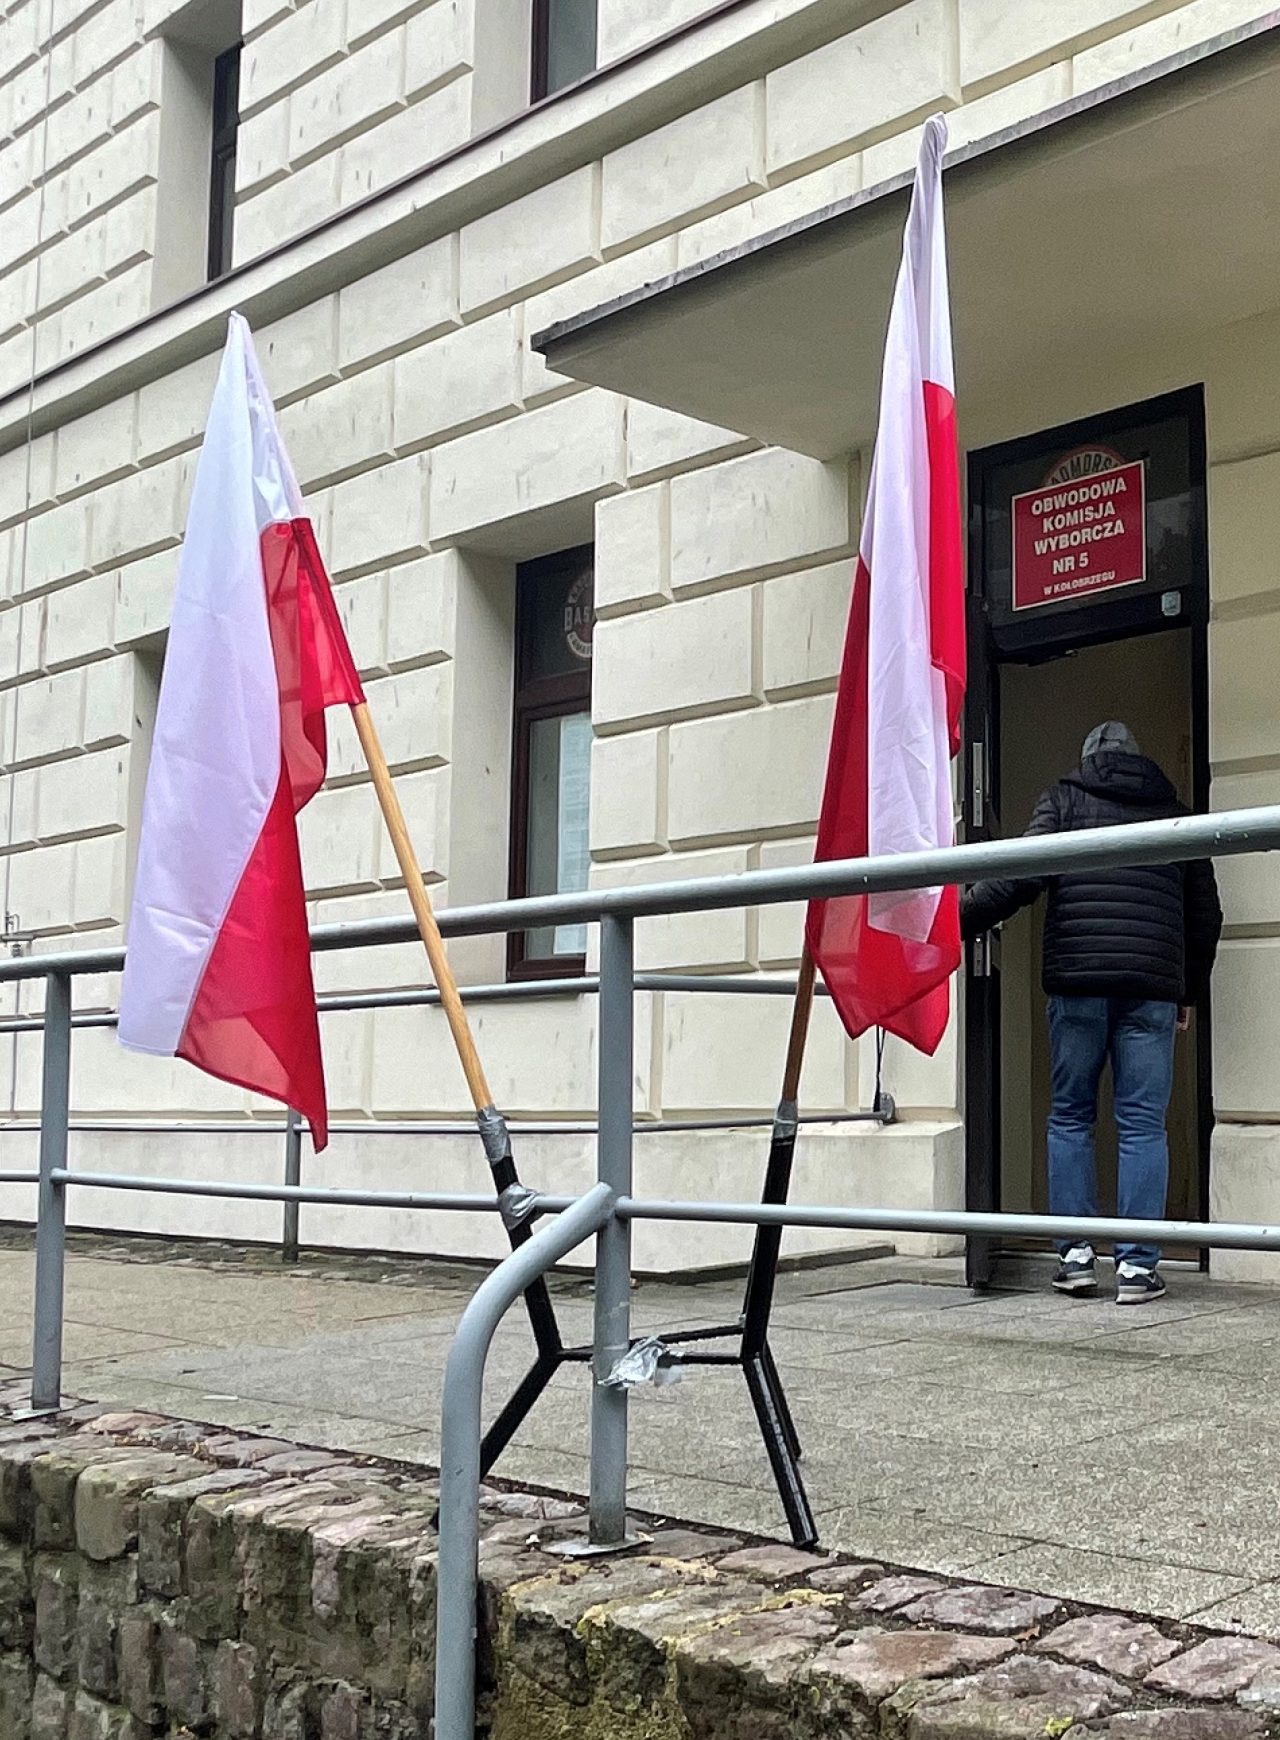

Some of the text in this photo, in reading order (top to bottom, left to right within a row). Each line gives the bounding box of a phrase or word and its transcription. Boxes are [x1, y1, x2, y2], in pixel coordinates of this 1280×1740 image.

[1031, 477, 1127, 515] OBWODOWA
[1043, 501, 1116, 534] KOMISJA
[1034, 519, 1125, 556] WYBORCZA
[1053, 552, 1089, 575] NR 5
[1043, 585, 1054, 596] W
